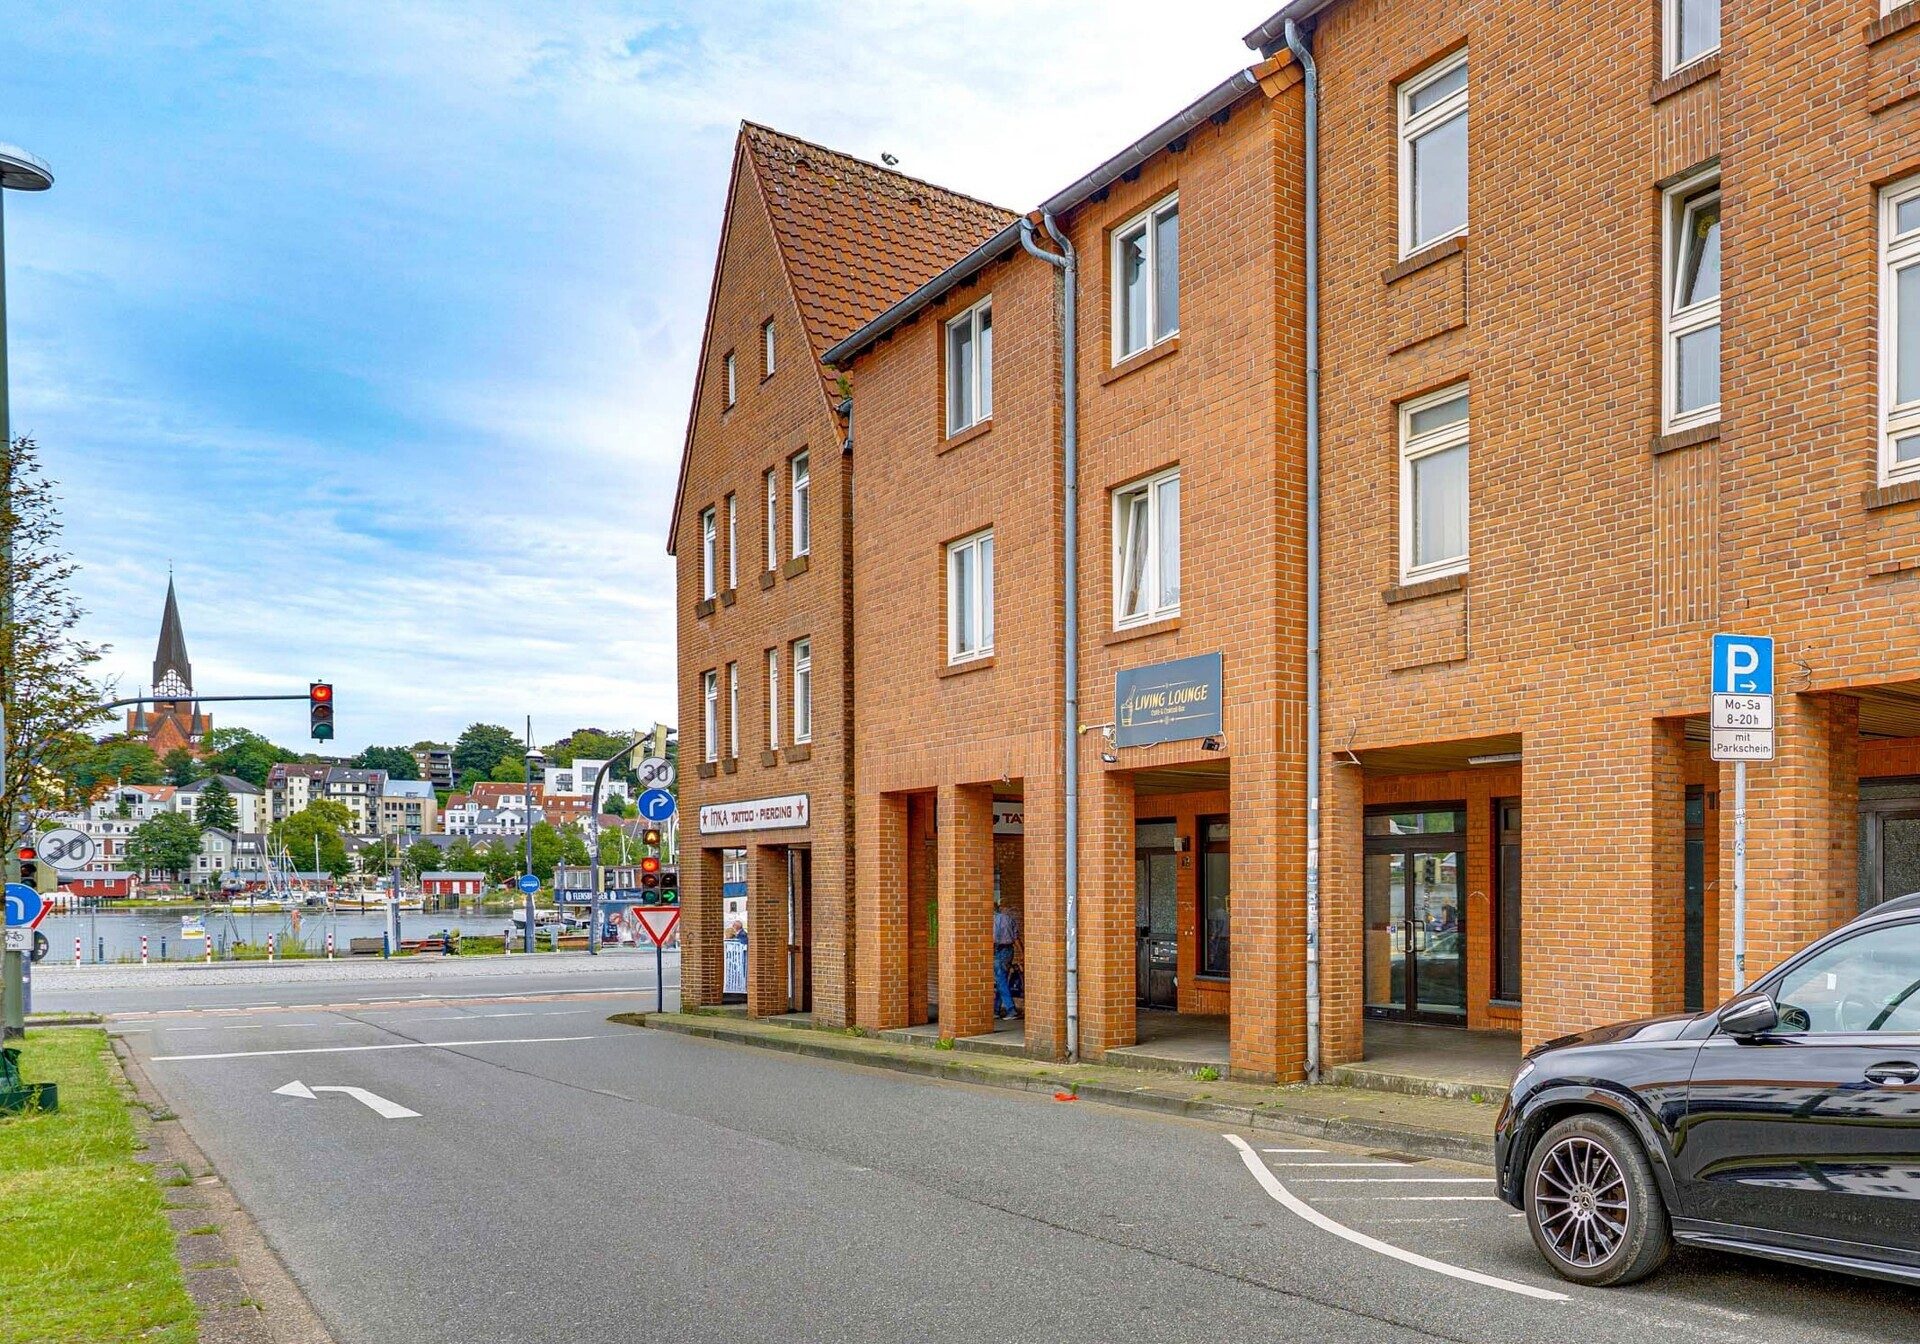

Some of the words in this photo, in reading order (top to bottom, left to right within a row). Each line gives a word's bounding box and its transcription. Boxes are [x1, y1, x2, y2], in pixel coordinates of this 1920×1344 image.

[1727, 643, 1759, 692] P
[1134, 691, 1166, 711] LIVING
[1168, 683, 1209, 706] LOUNGE
[1725, 699, 1761, 710] Mo-Sa
[1735, 732, 1750, 742] mit
[1717, 743, 1769, 754] Parkschein
[644, 764, 669, 782] 30
[731, 810, 755, 823] TATTOO
[759, 805, 792, 821] PIERCING
[47, 837, 87, 861] 30
